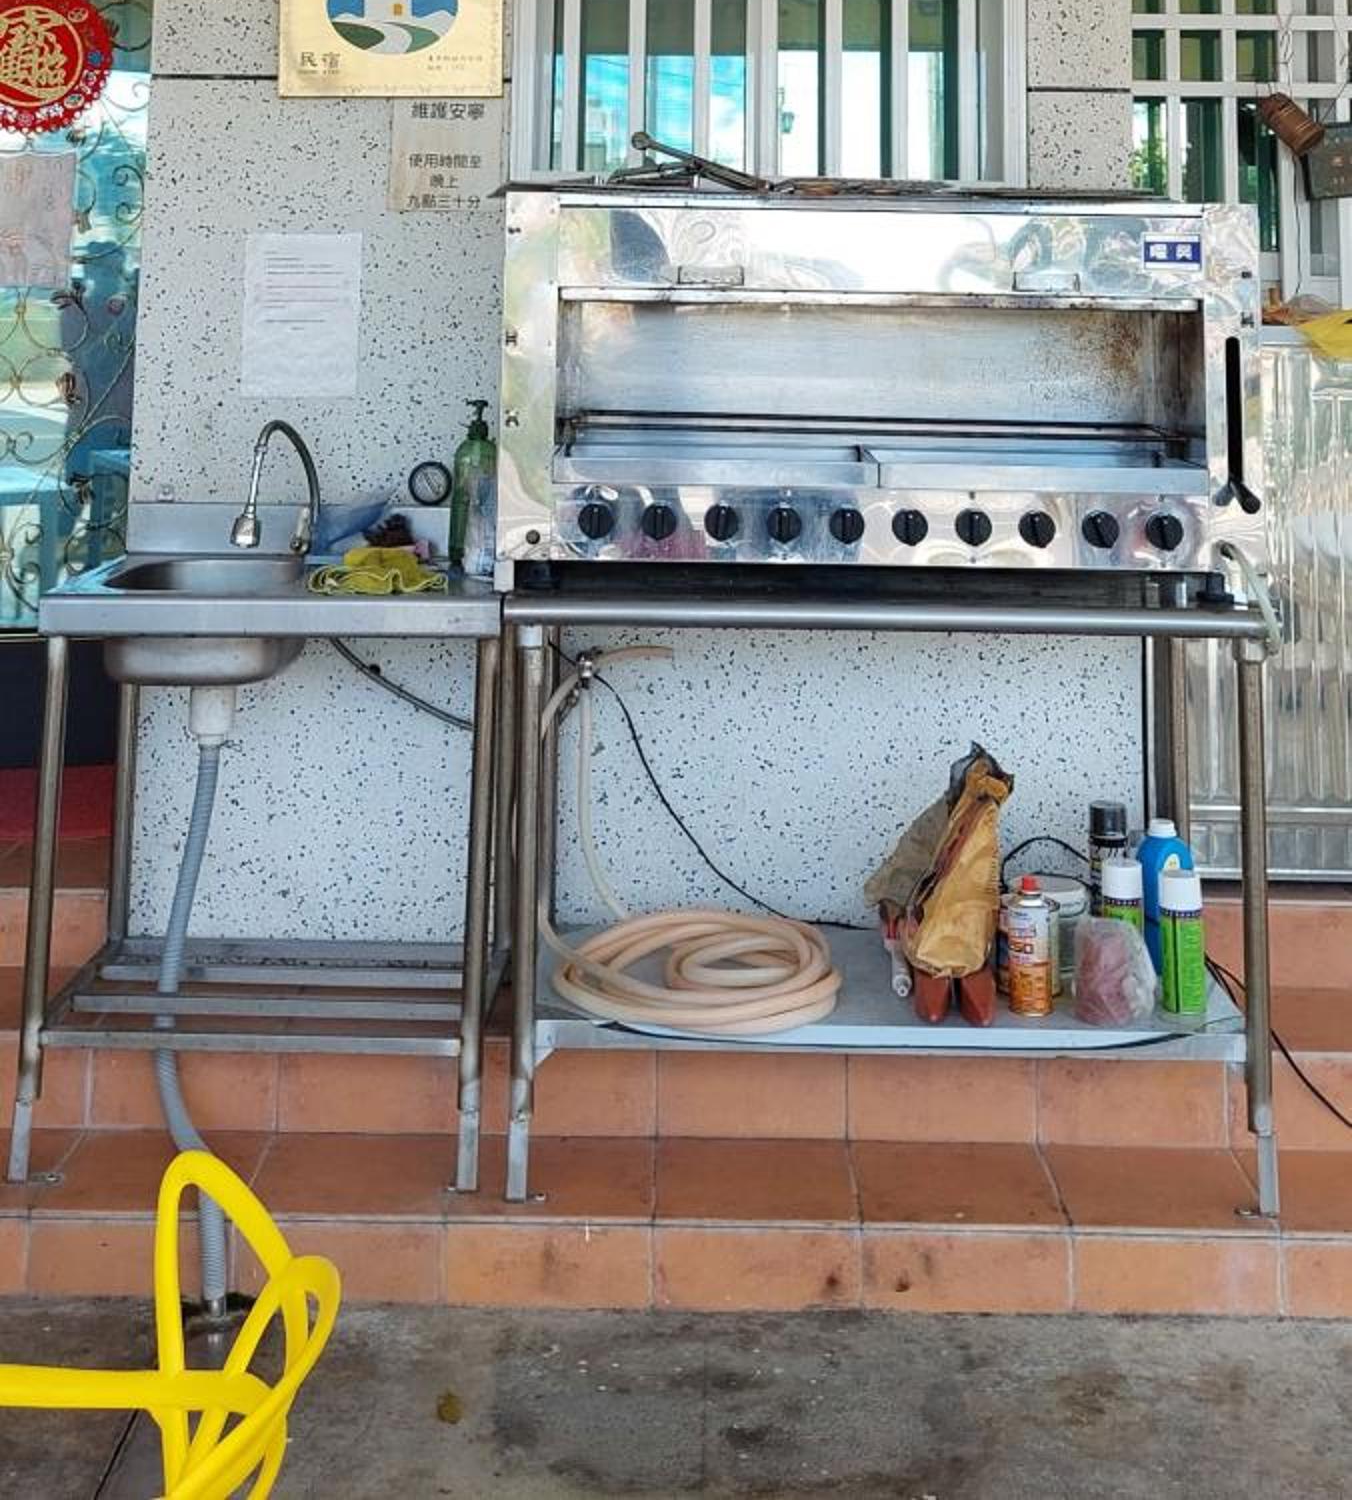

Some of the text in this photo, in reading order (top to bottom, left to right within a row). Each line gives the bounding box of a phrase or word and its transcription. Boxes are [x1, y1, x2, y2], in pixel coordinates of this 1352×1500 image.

[300, 51, 341, 69] 民宿
[411, 101, 485, 121] 維護安寧
[409, 153, 482, 169] 使用時間至
[429, 173, 460, 189] 晚上
[406, 193, 481, 209] 九點三十分
